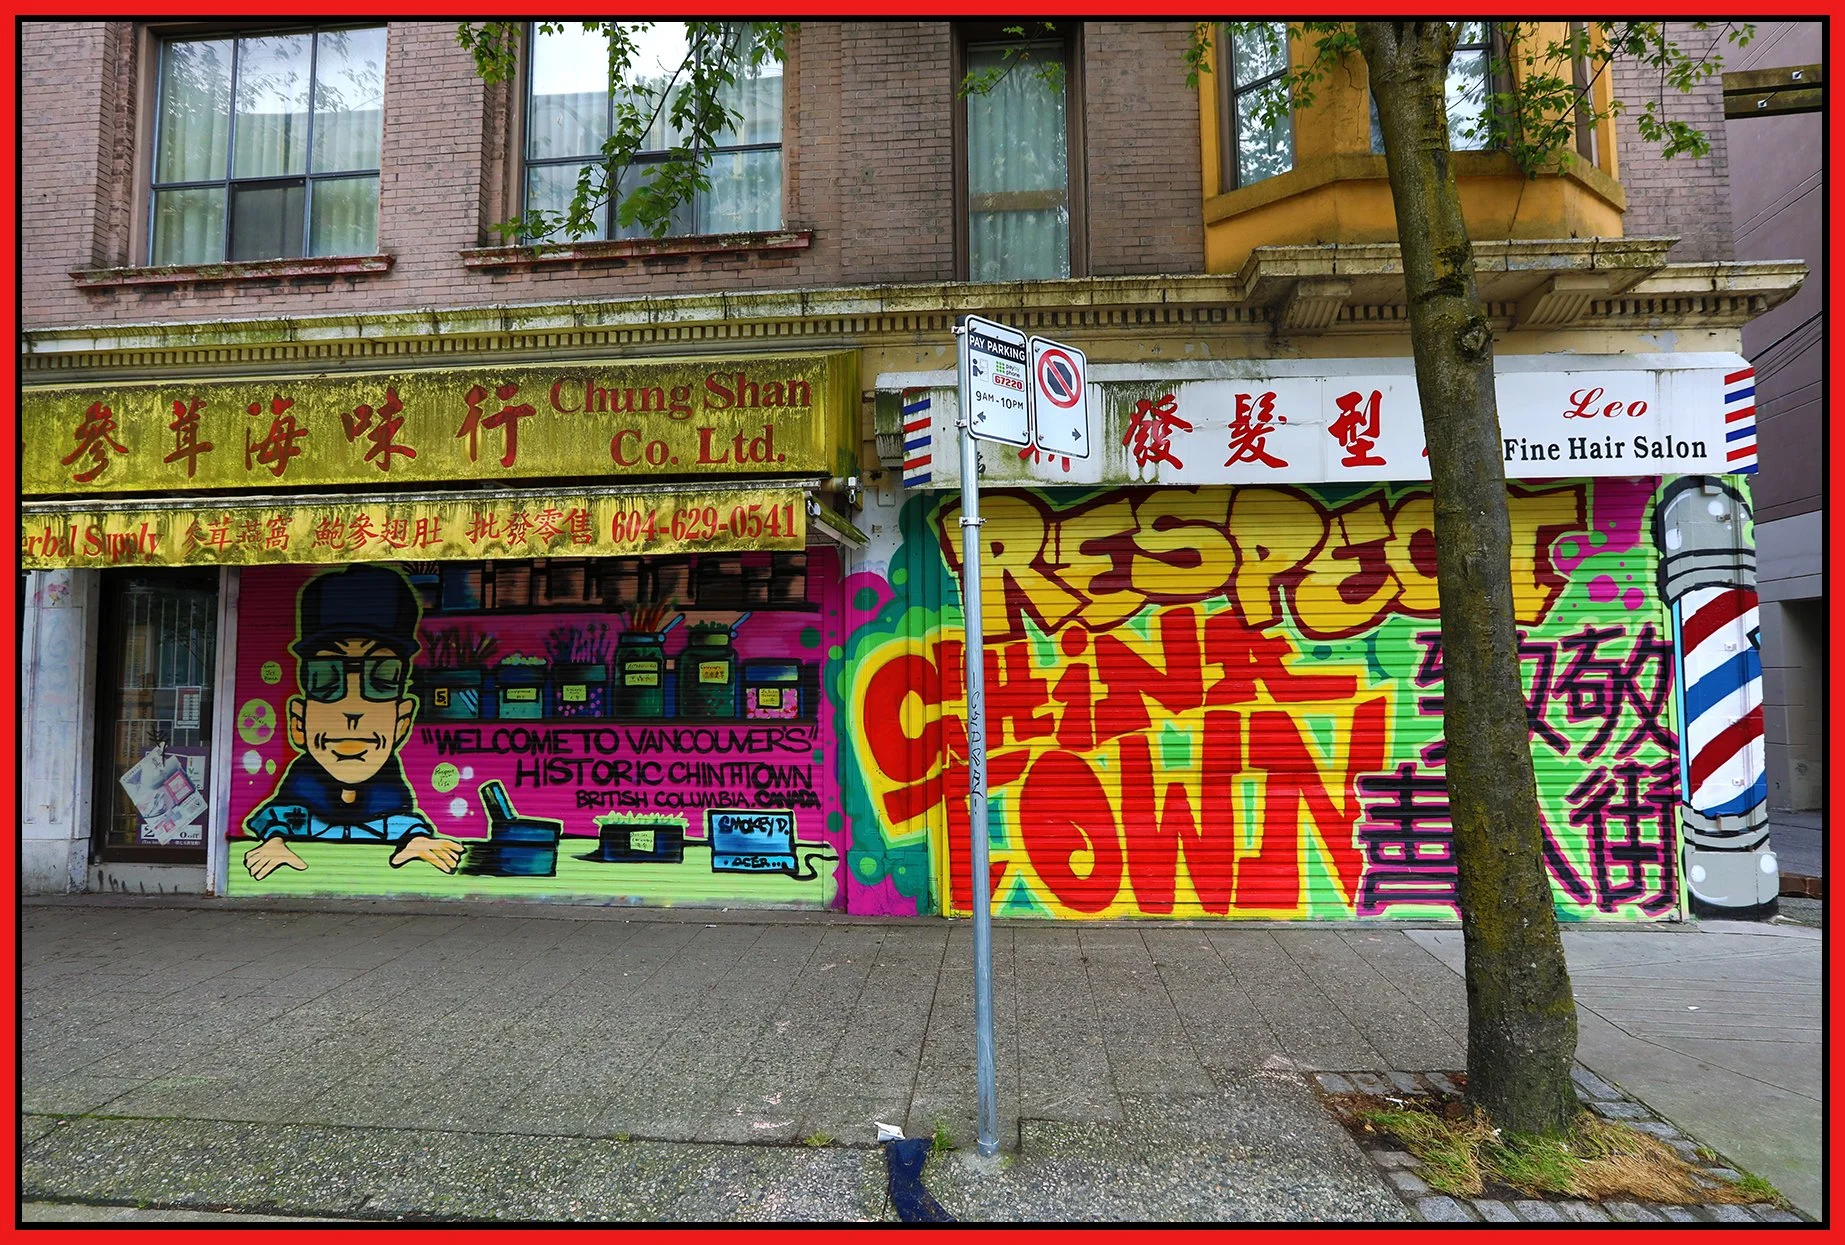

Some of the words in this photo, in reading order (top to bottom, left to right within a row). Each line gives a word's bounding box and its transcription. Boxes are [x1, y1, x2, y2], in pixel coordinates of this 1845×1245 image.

[969, 334, 986, 349] PAY
[987, 341, 1026, 361] PARKING
[549, 375, 694, 421] Chung
[703, 371, 812, 411] Shan
[994, 375, 1023, 390] 67220
[1563, 387, 1648, 419] Leo
[609, 429, 679, 466] Co.
[697, 425, 786, 465] Ltd.
[1504, 438, 1561, 461] Fine
[1568, 437, 1626, 460] Hair
[1633, 435, 1708, 459] Salon
[465, 508, 592, 547] 批發零售
[612, 503, 798, 544] 604-629-0541
[83, 522, 164, 563] Supply
[515, 757, 664, 788] HISTORIC
[576, 789, 648, 810] BRITISH
[754, 790, 821, 810] CANADA
